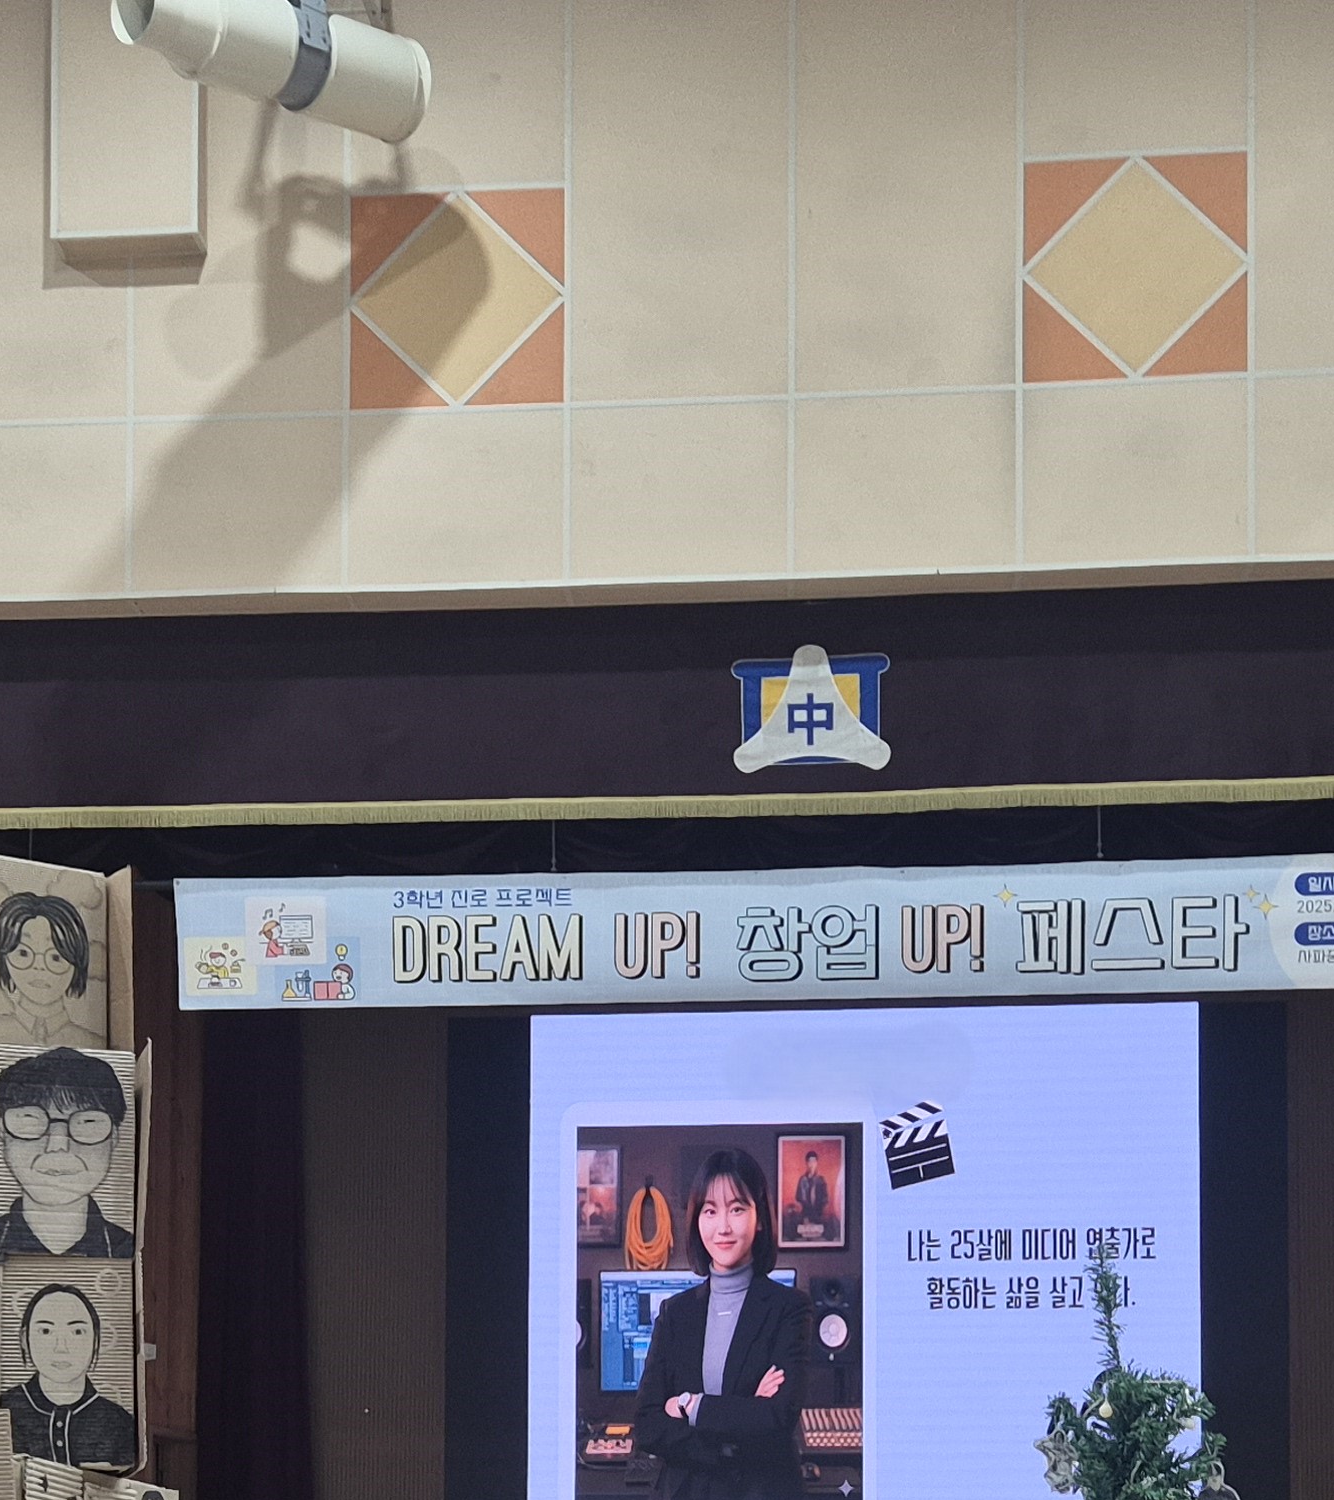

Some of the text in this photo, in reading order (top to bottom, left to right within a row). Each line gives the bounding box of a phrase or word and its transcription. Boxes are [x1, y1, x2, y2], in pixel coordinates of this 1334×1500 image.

[785, 692, 835, 747] 中
[393, 887, 573, 909] 3학년 진로 프로젝트
[391, 894, 1250, 984] DREAM UP! 창업 UP! 페스타
[907, 1226, 1157, 1262] 나는 25살에 미디어 연출가로
[926, 1276, 997, 1310] 활동하는
[1005, 1275, 1041, 1309] 삶을
[1049, 1275, 1085, 1309] 살고
